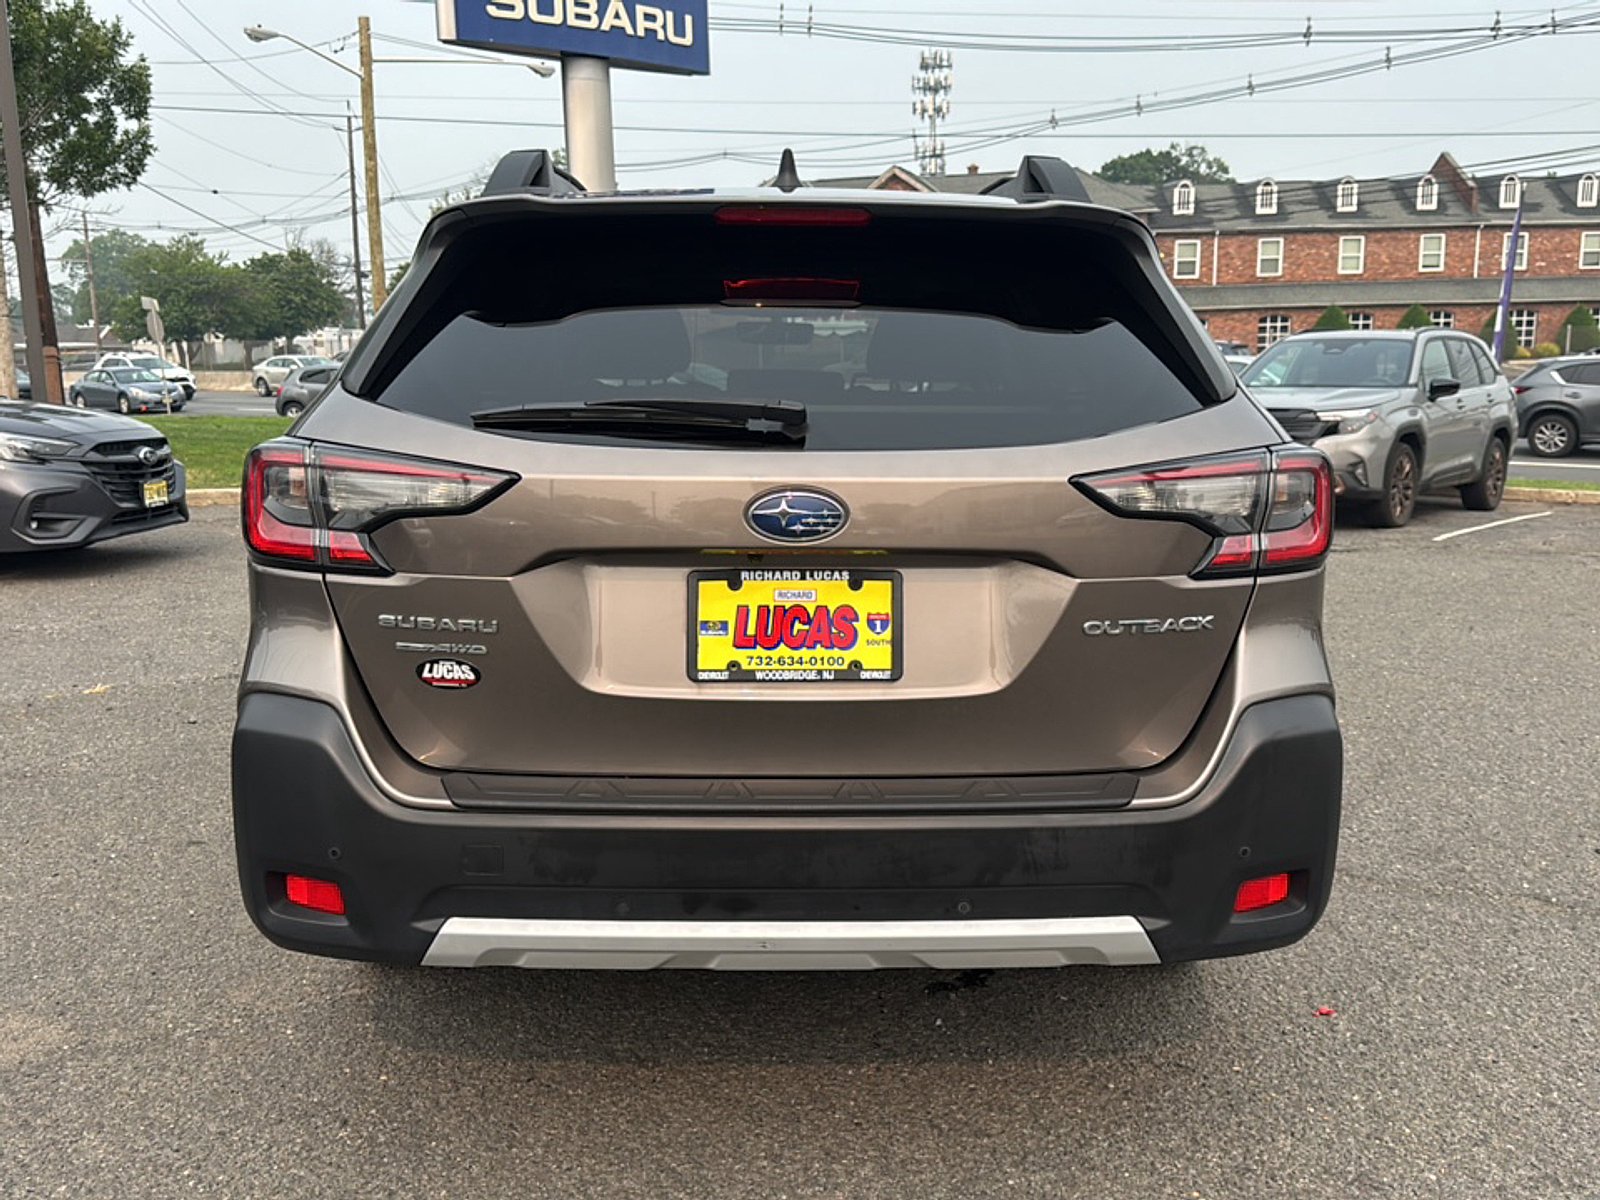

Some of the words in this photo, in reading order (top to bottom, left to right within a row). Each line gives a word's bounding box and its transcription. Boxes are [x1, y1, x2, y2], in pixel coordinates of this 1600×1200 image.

[486, 0, 693, 47] SUBARU
[741, 570, 800, 581] RICHARD
[806, 570, 850, 581] LUCAS
[777, 591, 813, 599] RICHARD
[378, 614, 498, 632] SUBARU
[733, 604, 860, 650] LUCAS
[873, 620, 882, 633] 1
[1083, 615, 1215, 635] OUTBACK
[746, 655, 845, 666] 732-634-0100
[421, 662, 476, 681] LUCAS
[822, 669, 835, 680] NJ
